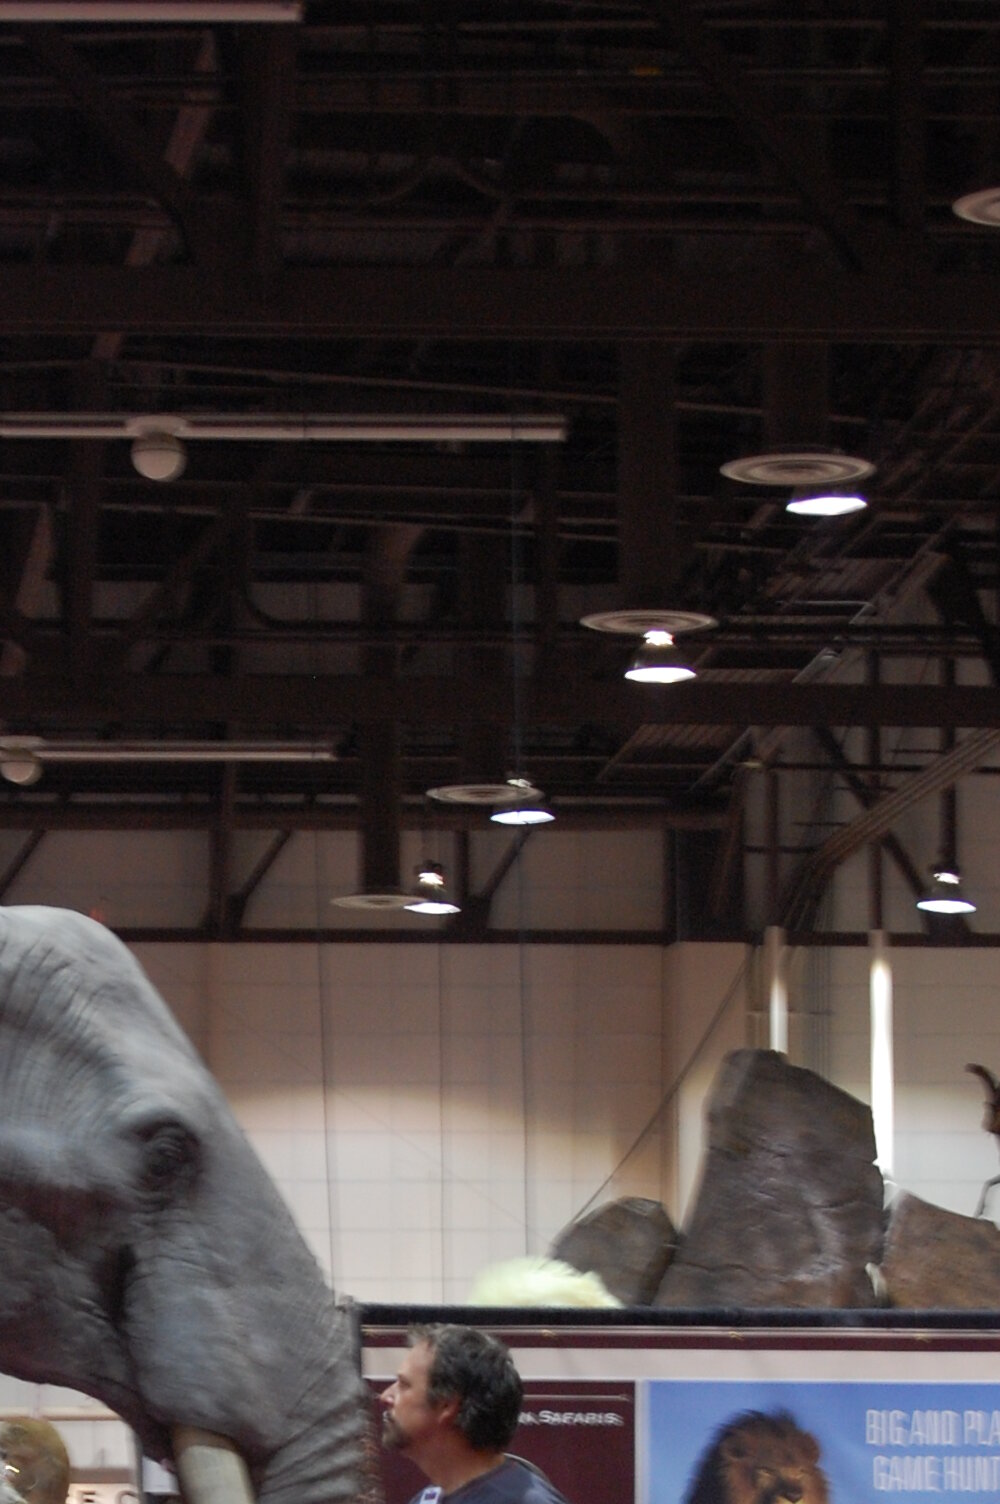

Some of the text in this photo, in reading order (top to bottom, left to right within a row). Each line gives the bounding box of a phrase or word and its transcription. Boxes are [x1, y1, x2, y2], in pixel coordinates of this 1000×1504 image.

[866, 1409, 909, 1446] BIG
[910, 1409, 961, 1446] AND
[873, 1455, 941, 1491] GAME
